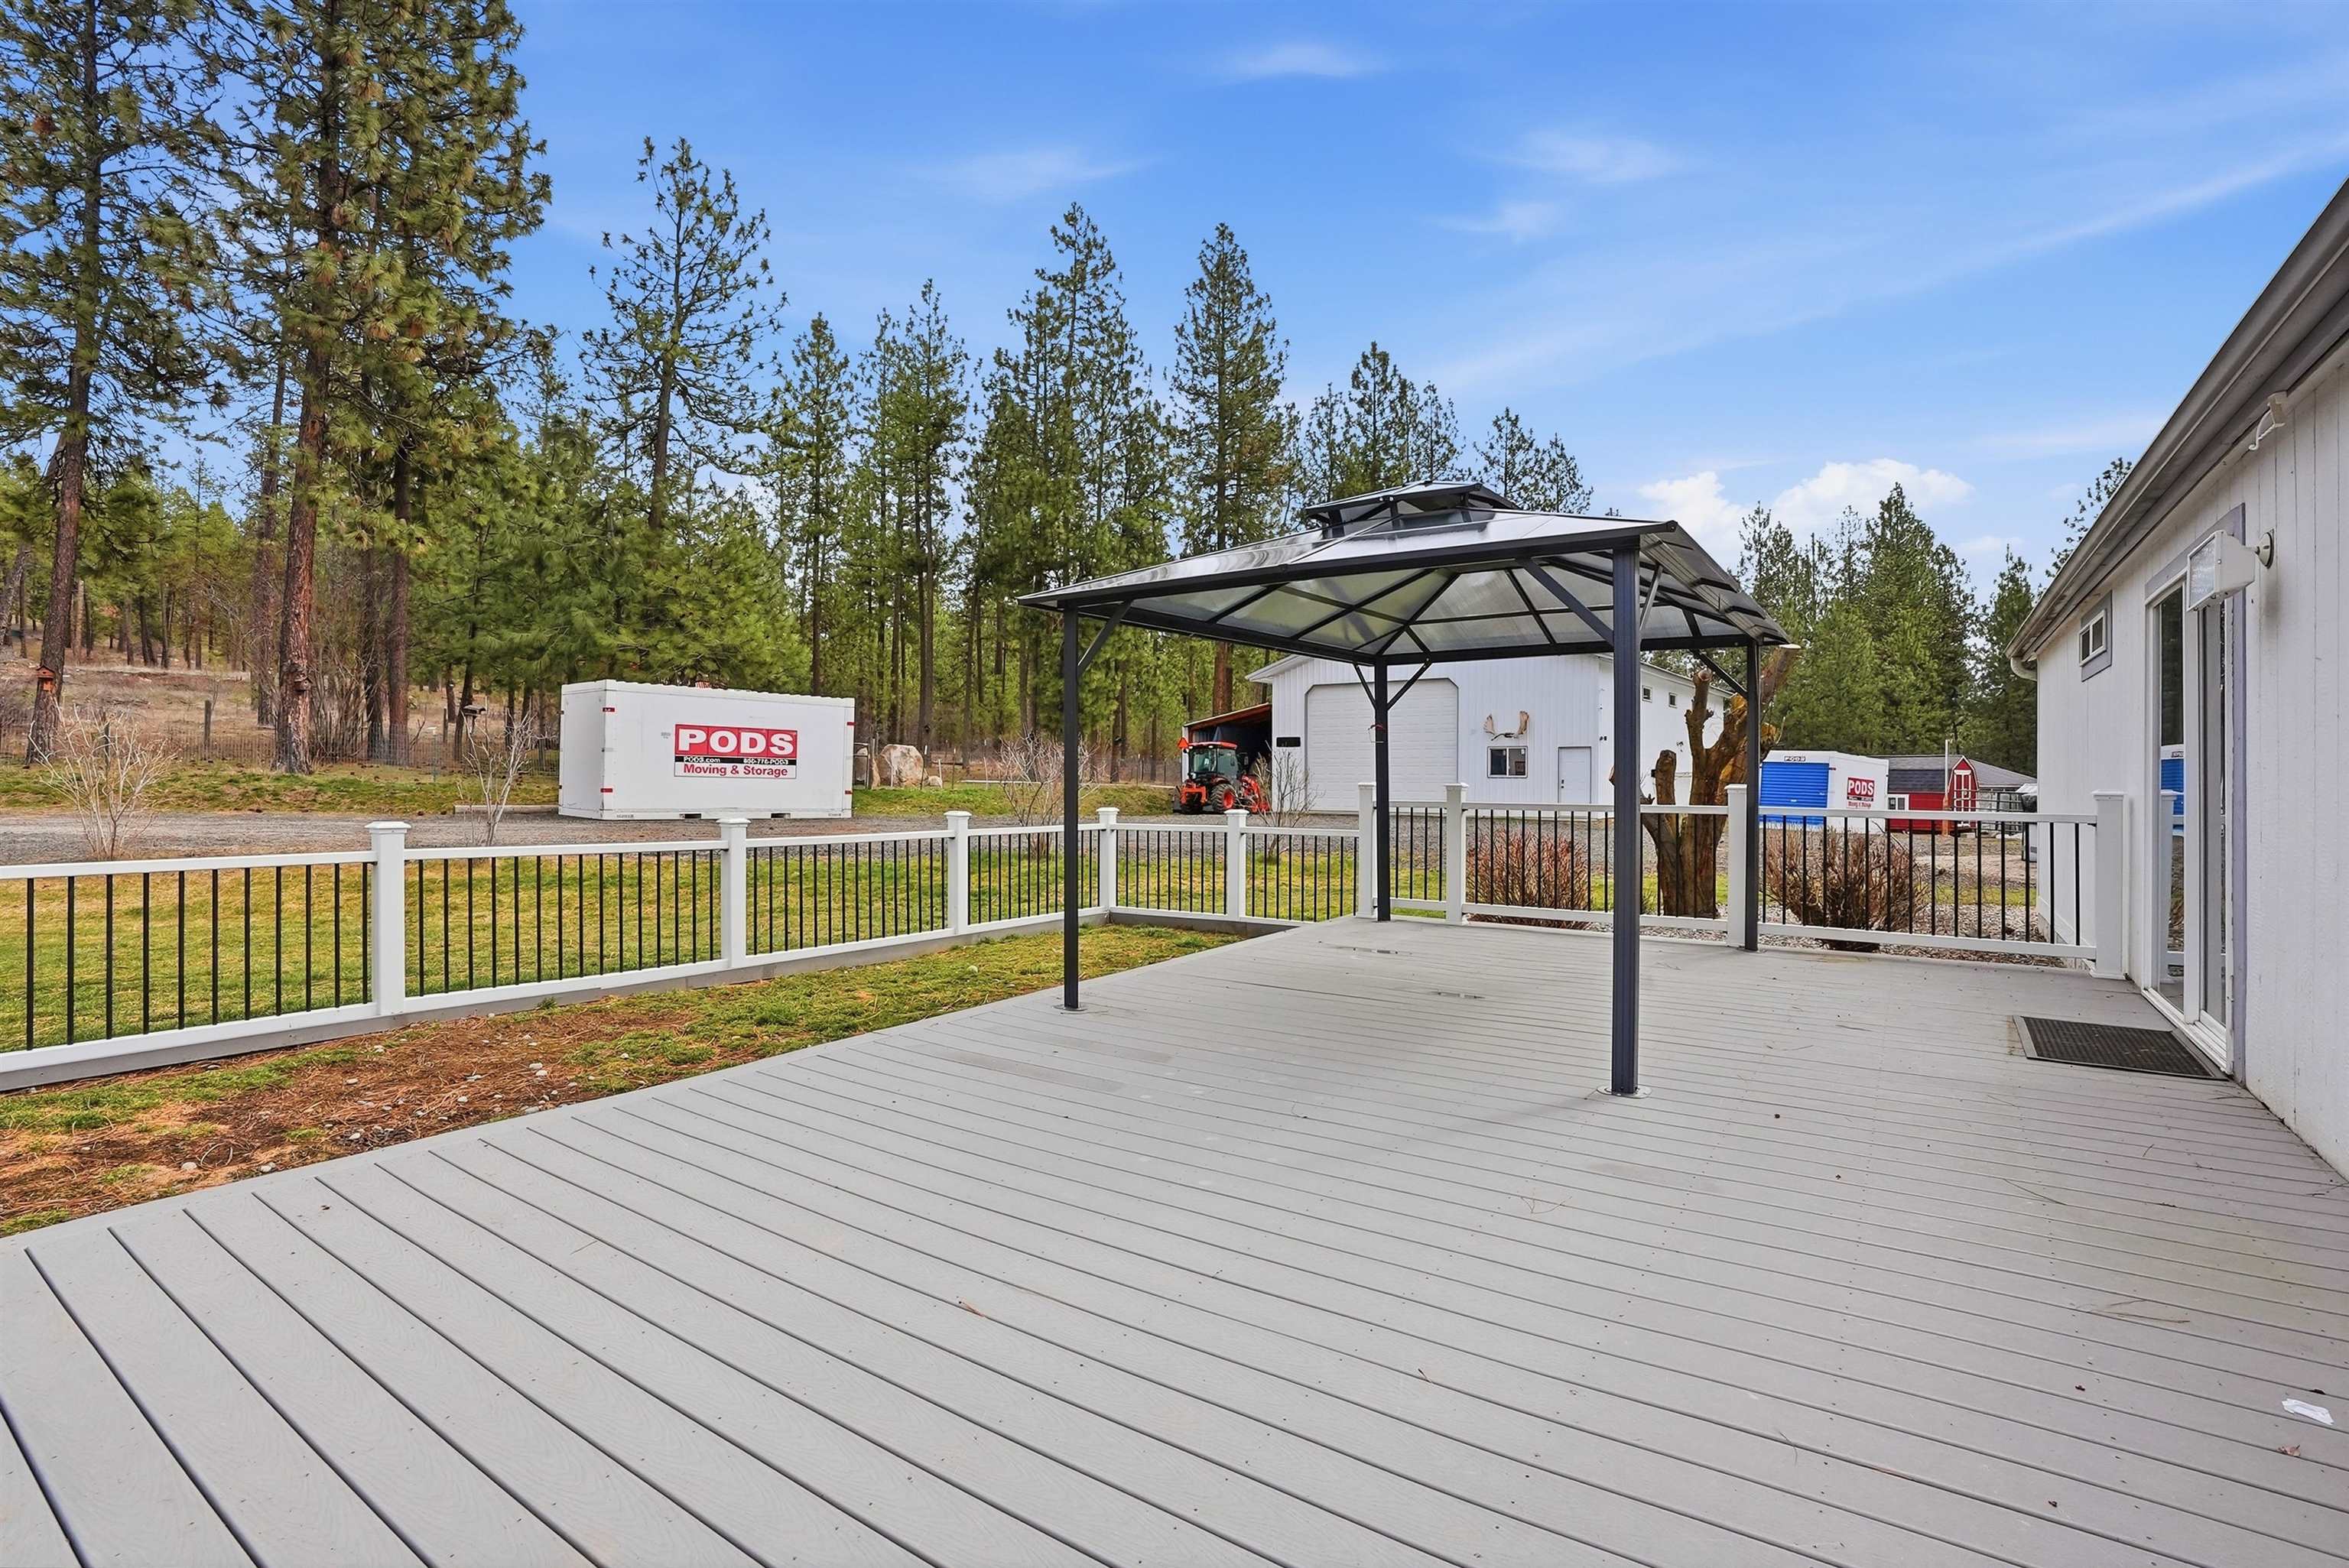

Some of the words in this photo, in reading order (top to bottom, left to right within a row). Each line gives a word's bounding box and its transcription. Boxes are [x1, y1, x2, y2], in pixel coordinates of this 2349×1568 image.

[678, 728, 794, 755] PODS
[684, 764, 726, 776] Moving
[730, 765, 739, 774] &
[743, 765, 788, 778] Storage
[1848, 780, 1873, 795] PODS
